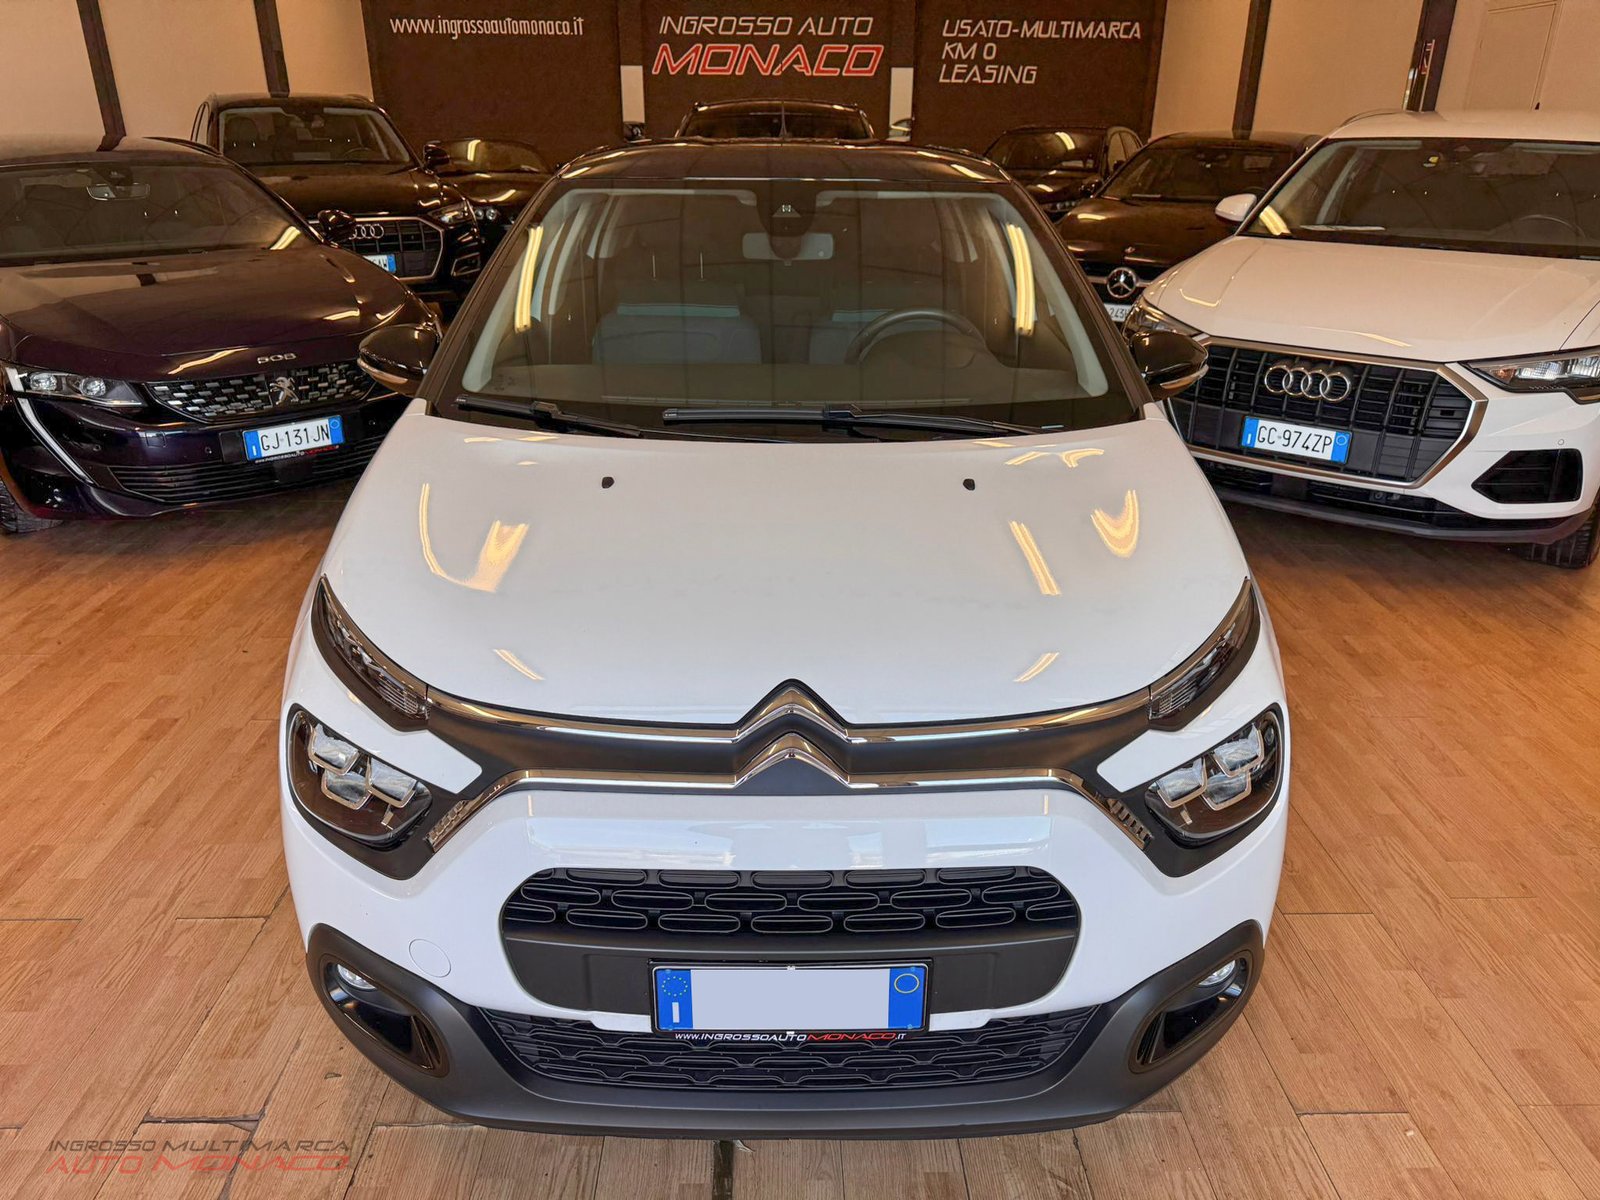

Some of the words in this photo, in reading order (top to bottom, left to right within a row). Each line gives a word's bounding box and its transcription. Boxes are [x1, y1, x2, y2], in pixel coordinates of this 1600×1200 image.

[390, 16, 584, 40] www.ingrossoautomonaco.it
[659, 15, 792, 36] INGROSSO
[797, 16, 874, 36] AUTO
[942, 19, 1141, 39] USATO-MULTIMARCA
[652, 43, 885, 77] MONACO
[942, 42, 977, 60] KM
[939, 64, 1038, 84] LEASING
